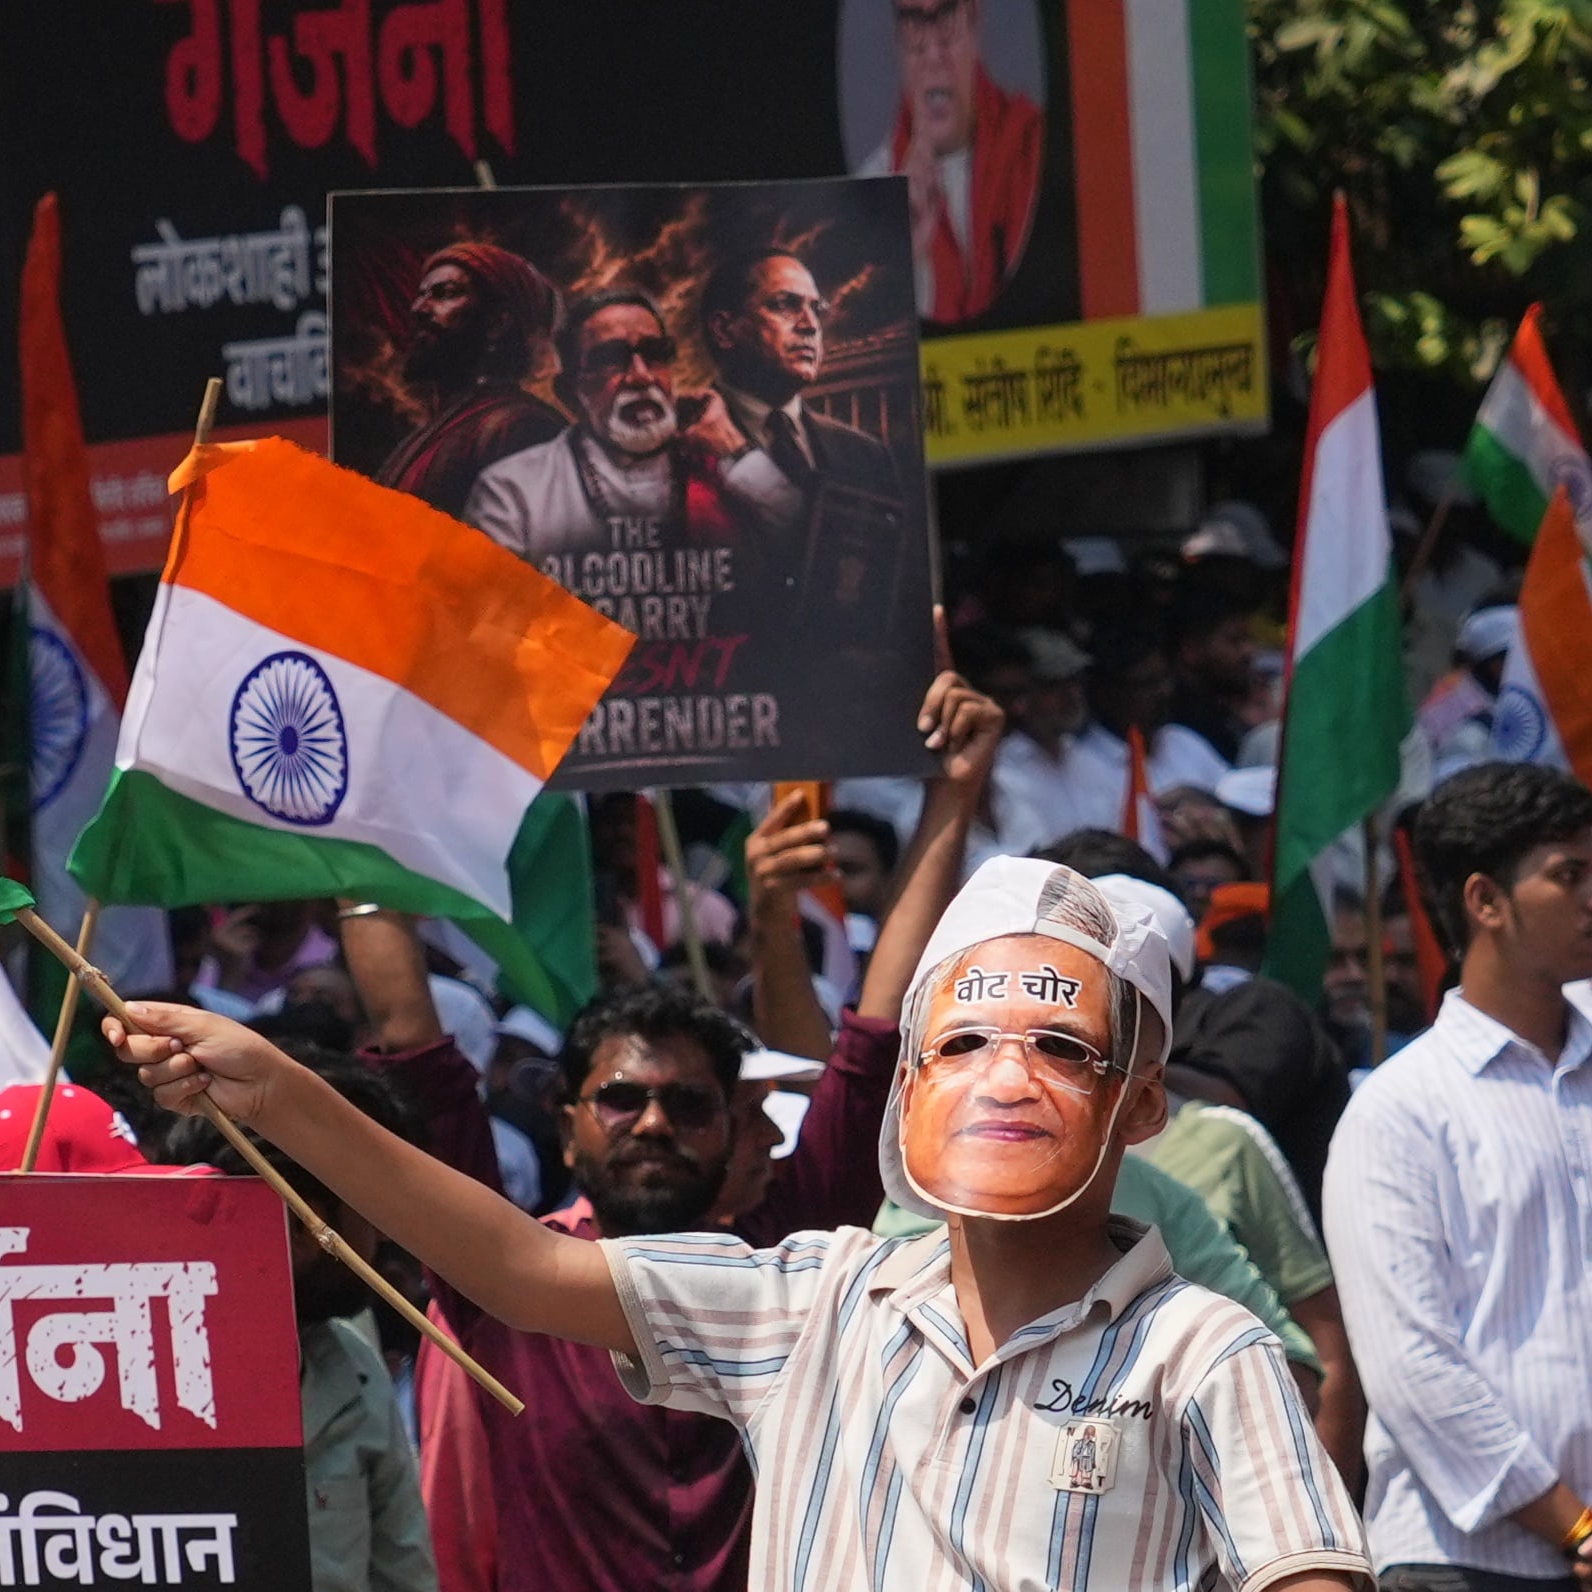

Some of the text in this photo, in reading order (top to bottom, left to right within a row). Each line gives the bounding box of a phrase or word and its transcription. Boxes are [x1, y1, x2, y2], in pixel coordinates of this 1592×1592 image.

[130, 203, 312, 316] लोकशाही
[607, 516, 662, 548] THE
[957, 966, 1080, 1007] वोट चोर
[1034, 1378, 1153, 1421] Denim
